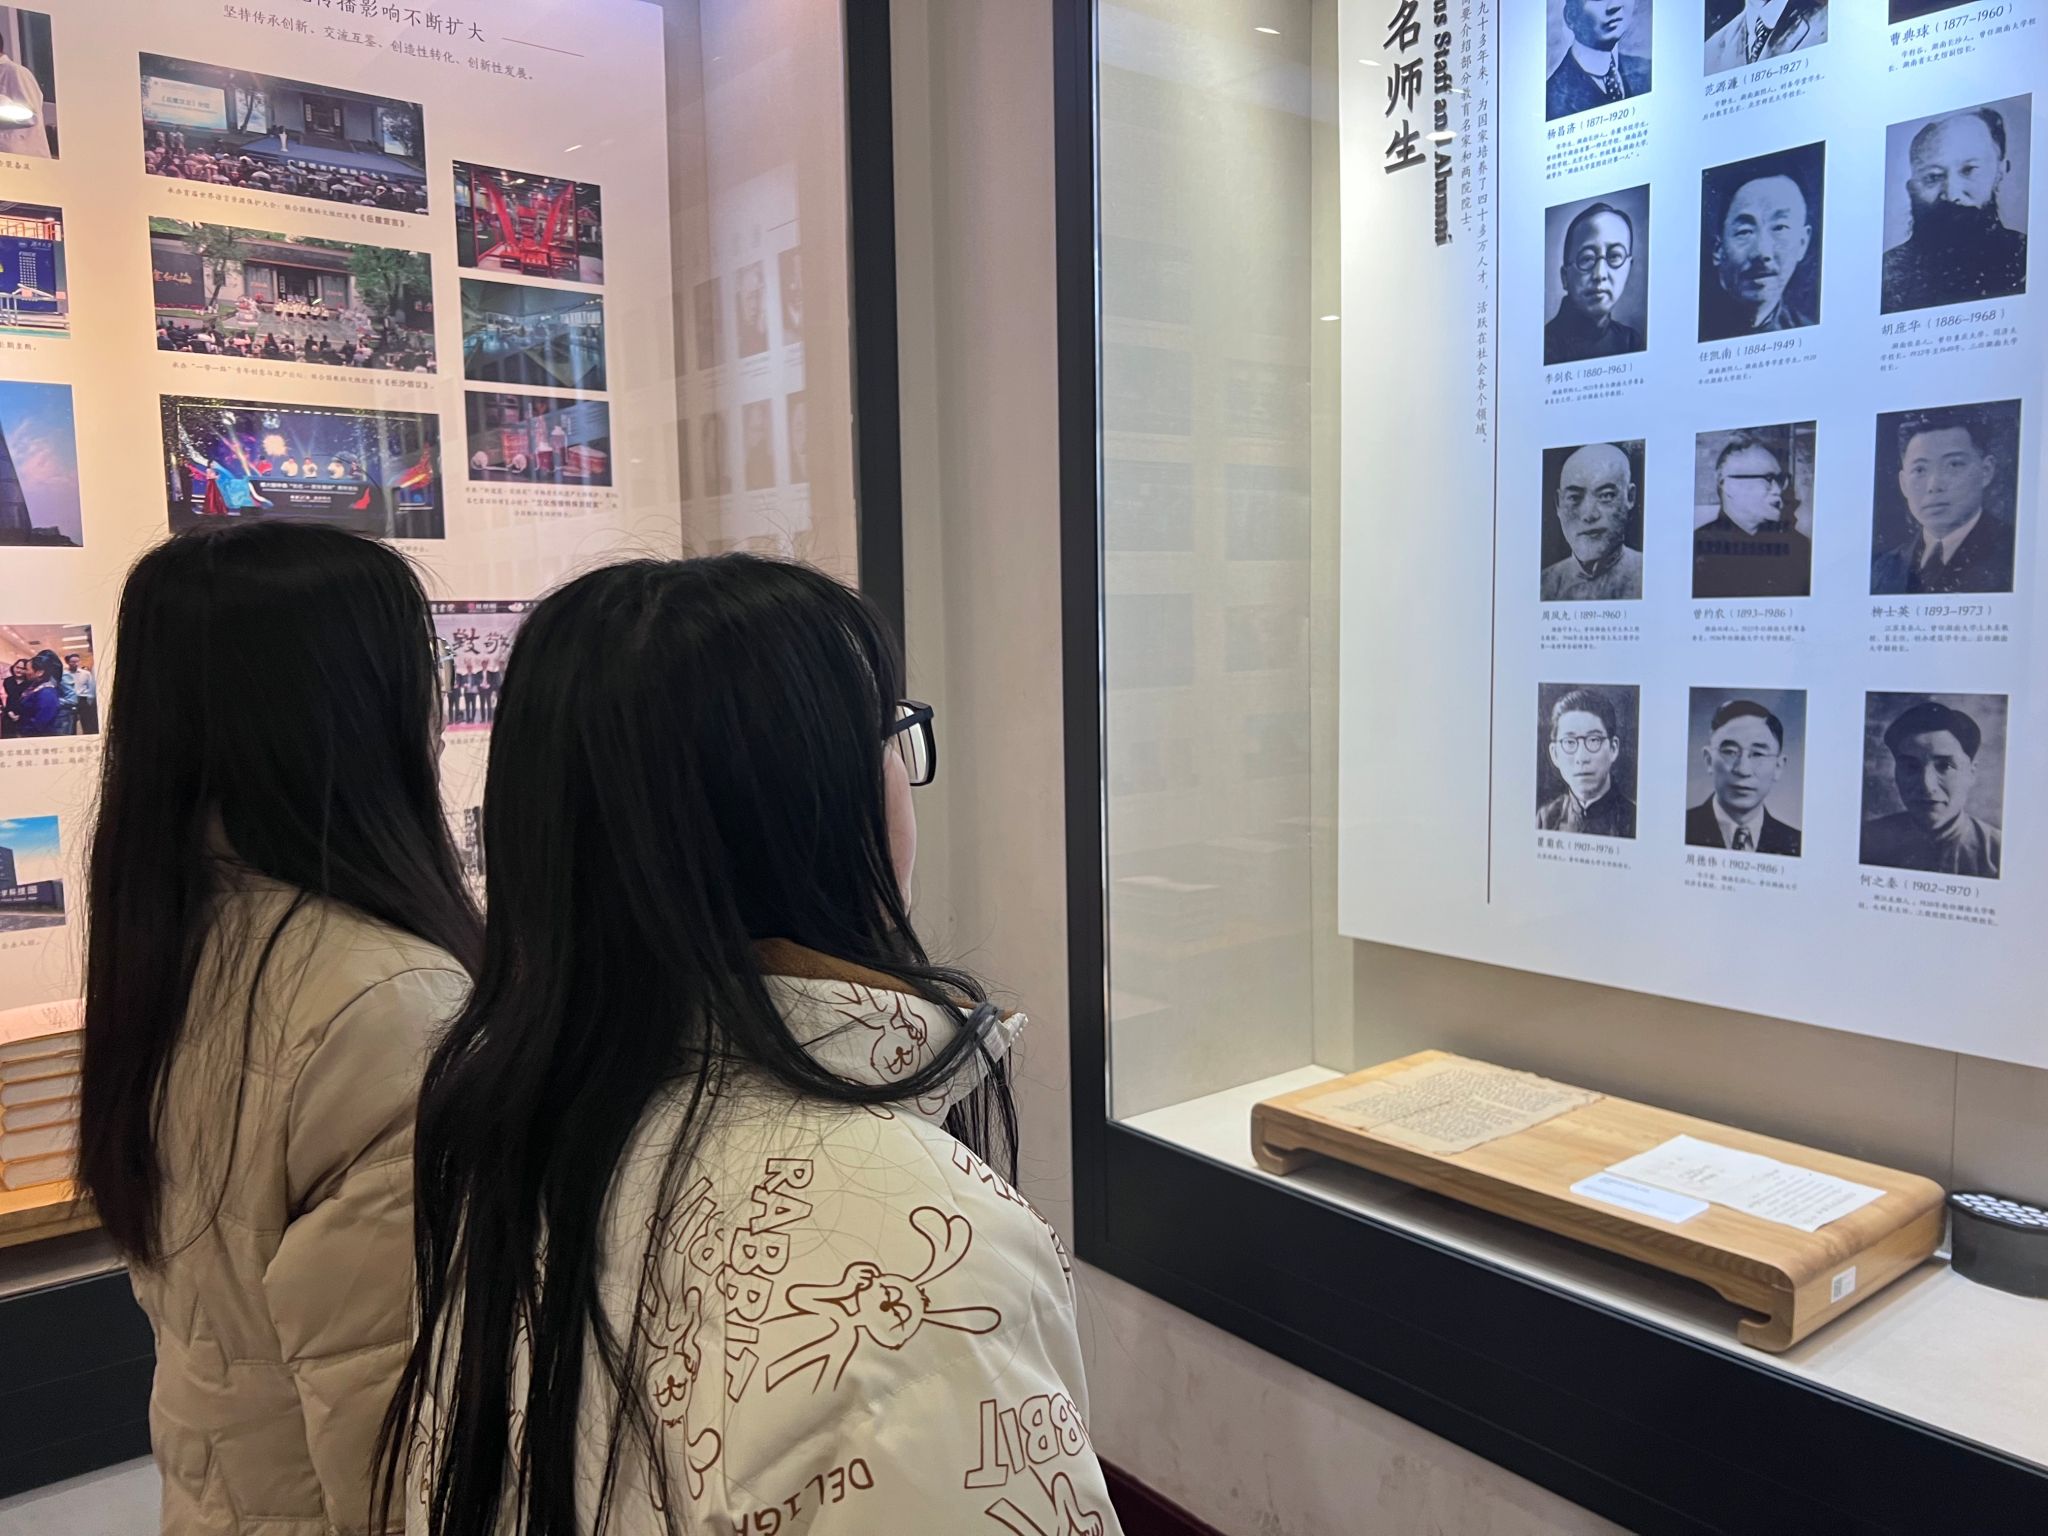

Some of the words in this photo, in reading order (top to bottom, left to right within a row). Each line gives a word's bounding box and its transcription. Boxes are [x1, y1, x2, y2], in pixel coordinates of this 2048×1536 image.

[298, 0, 486, 43] 传播影响不断扩大
[1433, 31, 1453, 94] Staff
[1434, 151, 1454, 247] Alumni
